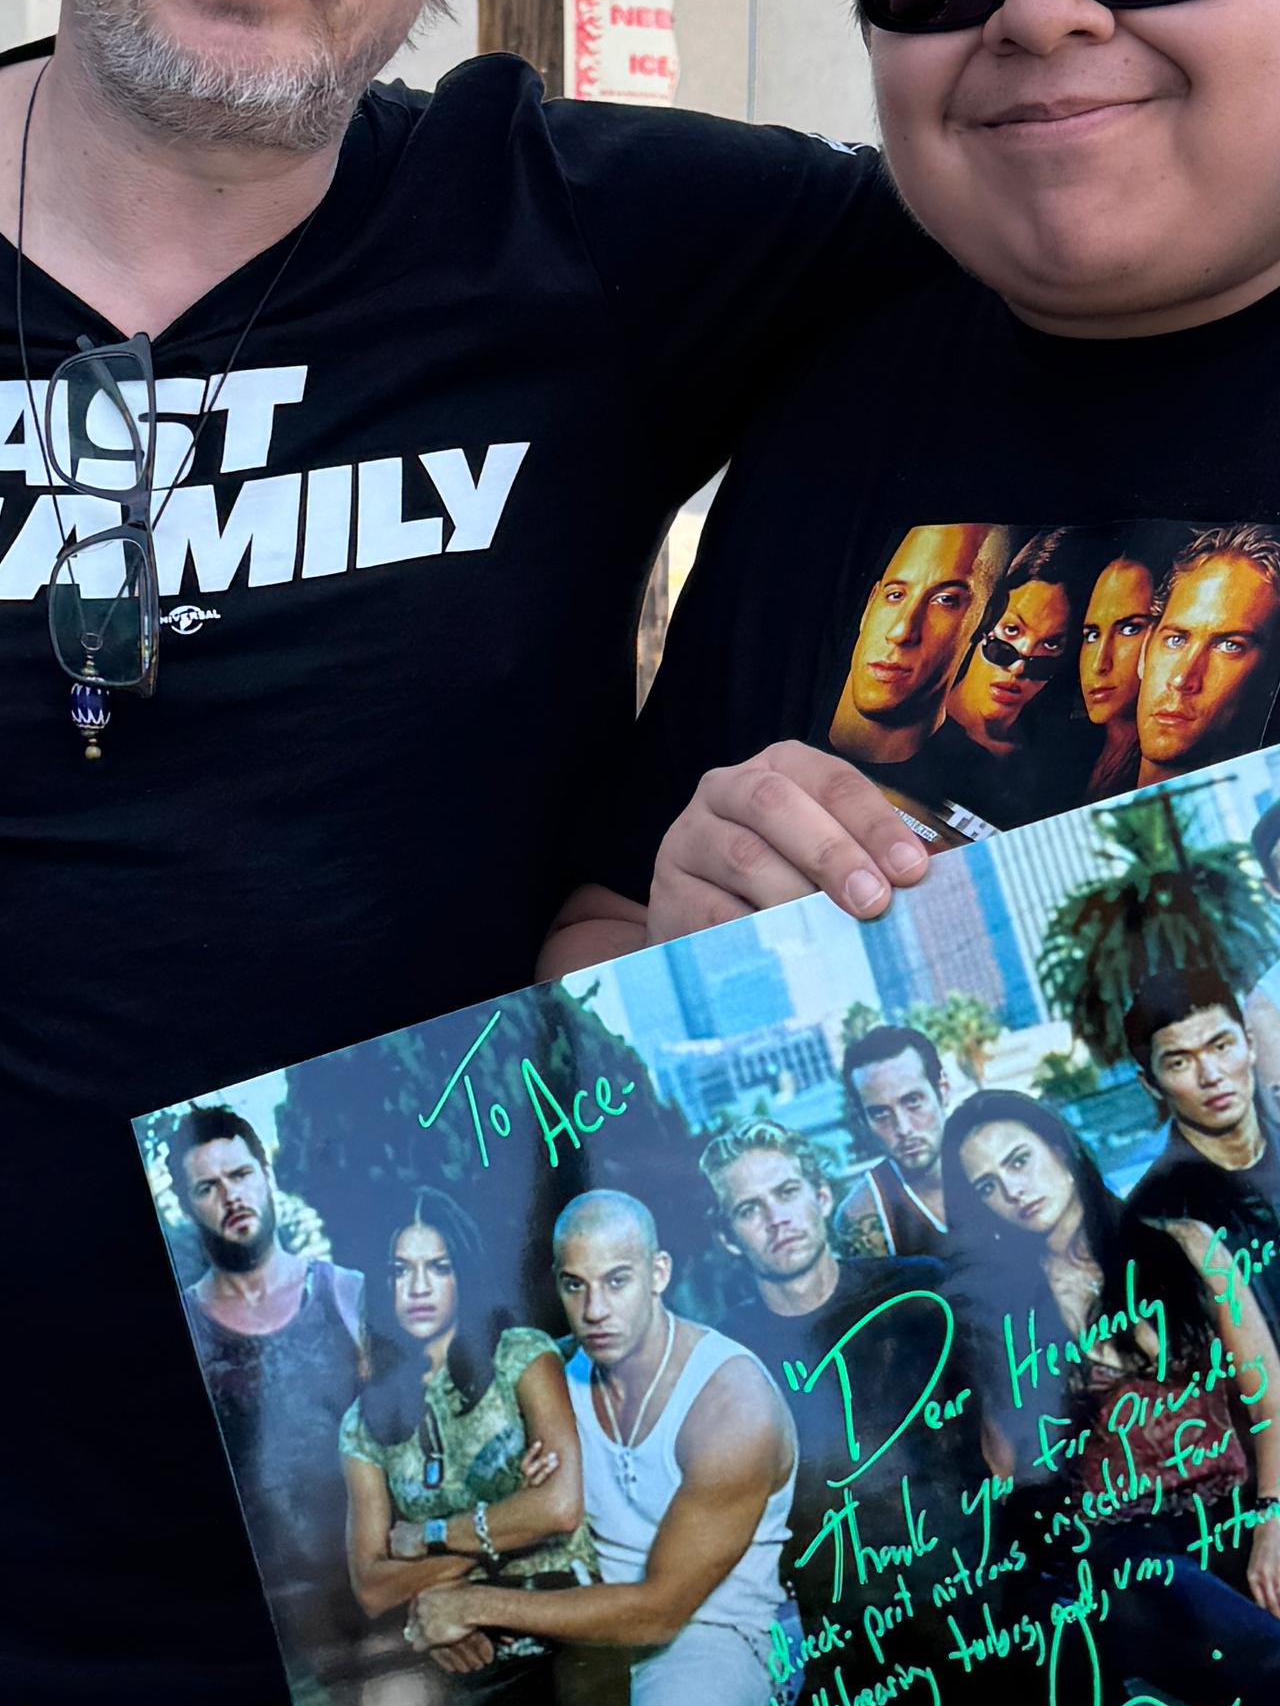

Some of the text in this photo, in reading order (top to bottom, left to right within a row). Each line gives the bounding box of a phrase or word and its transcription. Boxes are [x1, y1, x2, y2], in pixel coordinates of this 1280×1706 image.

[159, 608, 221, 624] NIVERSAL
[419, 1010, 513, 1169] To
[1003, 1258, 1166, 1410] Heavenly
[793, 1476, 939, 1604] Thank
